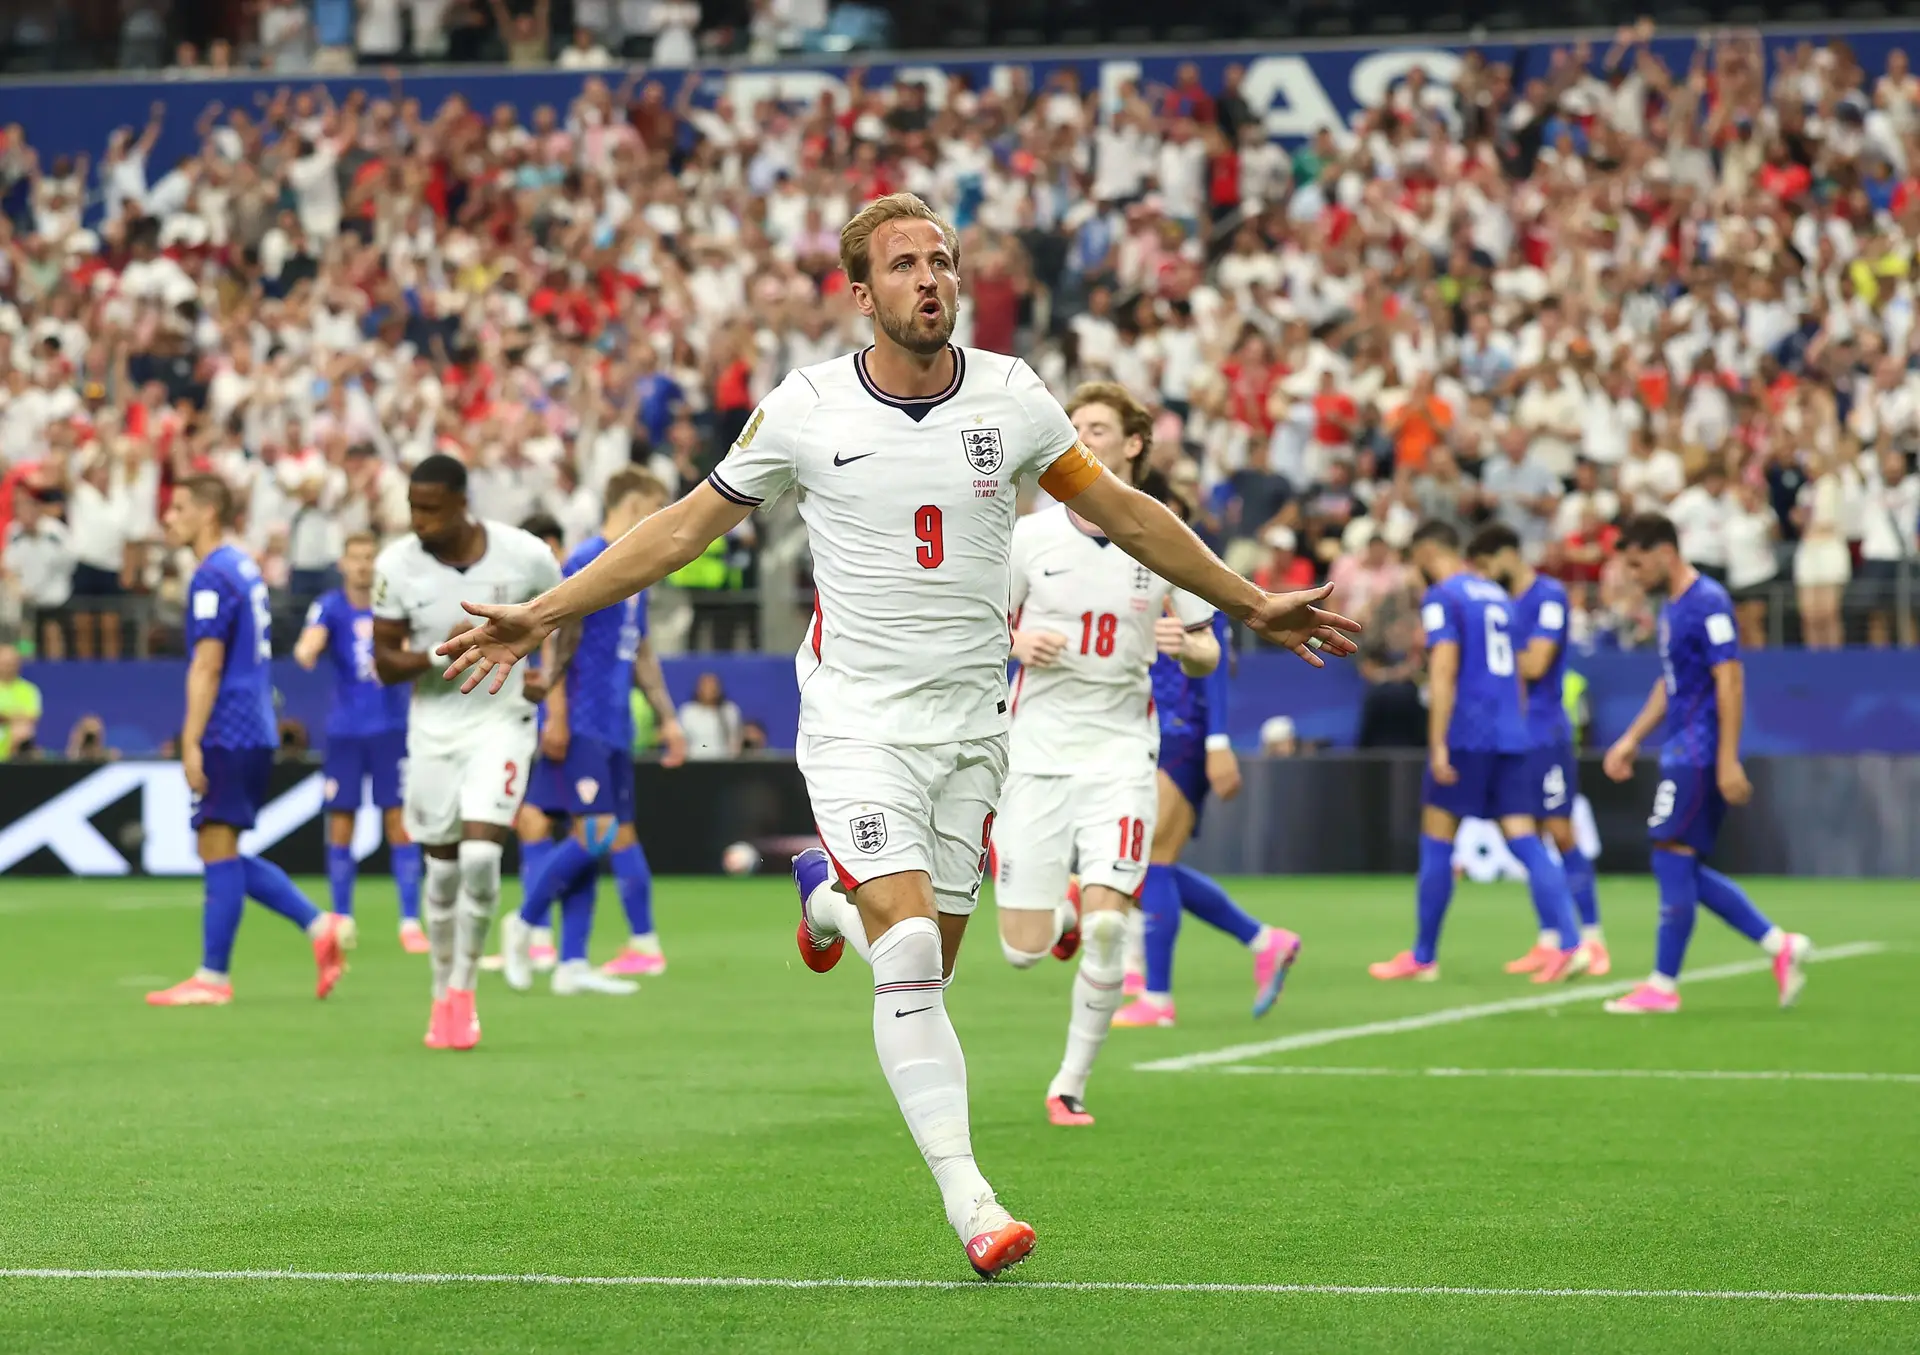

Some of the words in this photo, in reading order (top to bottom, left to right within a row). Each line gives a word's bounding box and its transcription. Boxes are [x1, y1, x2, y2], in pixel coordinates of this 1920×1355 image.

[973, 480, 998, 488] CROATIA
[915, 505, 944, 569] 9
[1080, 611, 1118, 657] 18
[1484, 603, 1514, 677] 6
[504, 761, 517, 797] 2
[1118, 816, 1144, 862] 18
